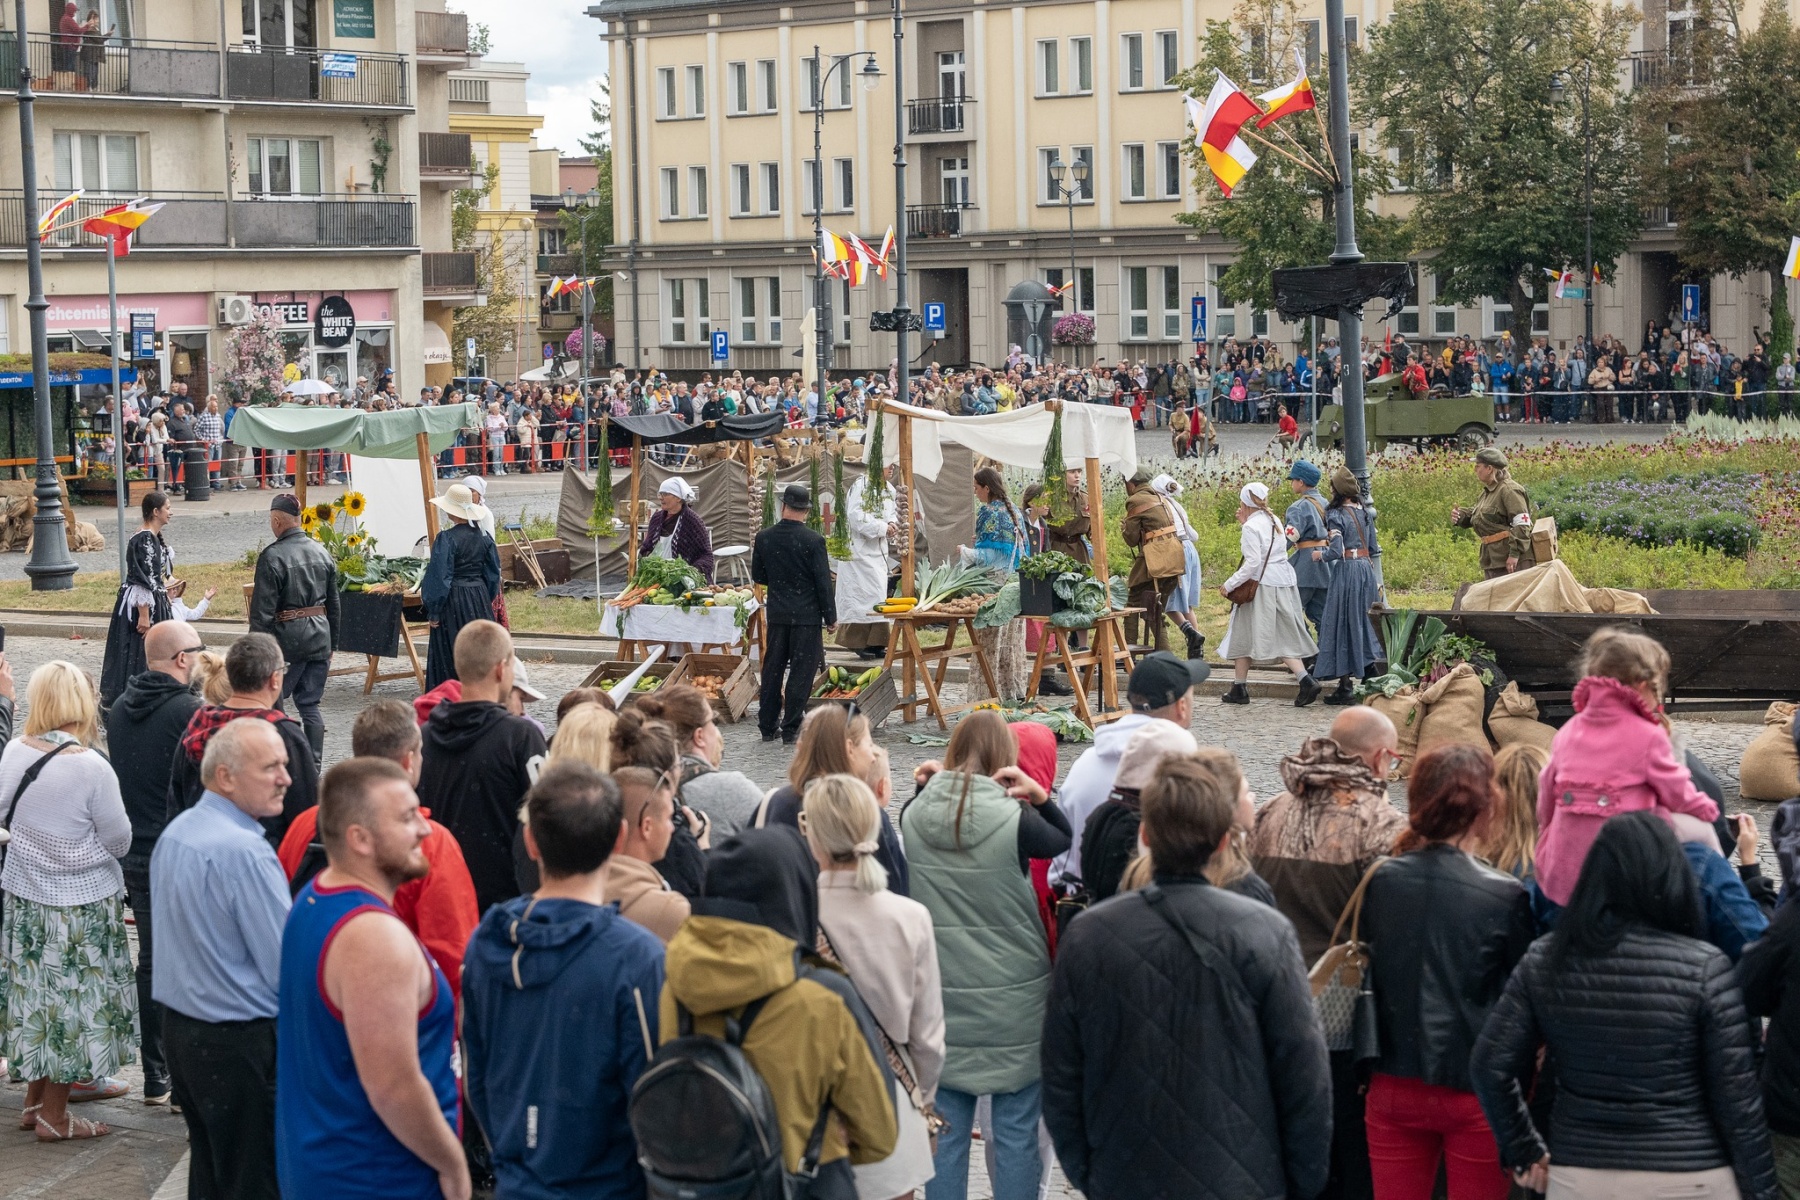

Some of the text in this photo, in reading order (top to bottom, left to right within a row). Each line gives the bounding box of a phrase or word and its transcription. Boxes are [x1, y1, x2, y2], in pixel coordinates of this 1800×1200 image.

[321, 305, 334, 317] the
[929, 305, 941, 322] P
[321, 316, 353, 327] WHITE
[322, 326, 348, 338] BEAR
[716, 334, 726, 352] P
